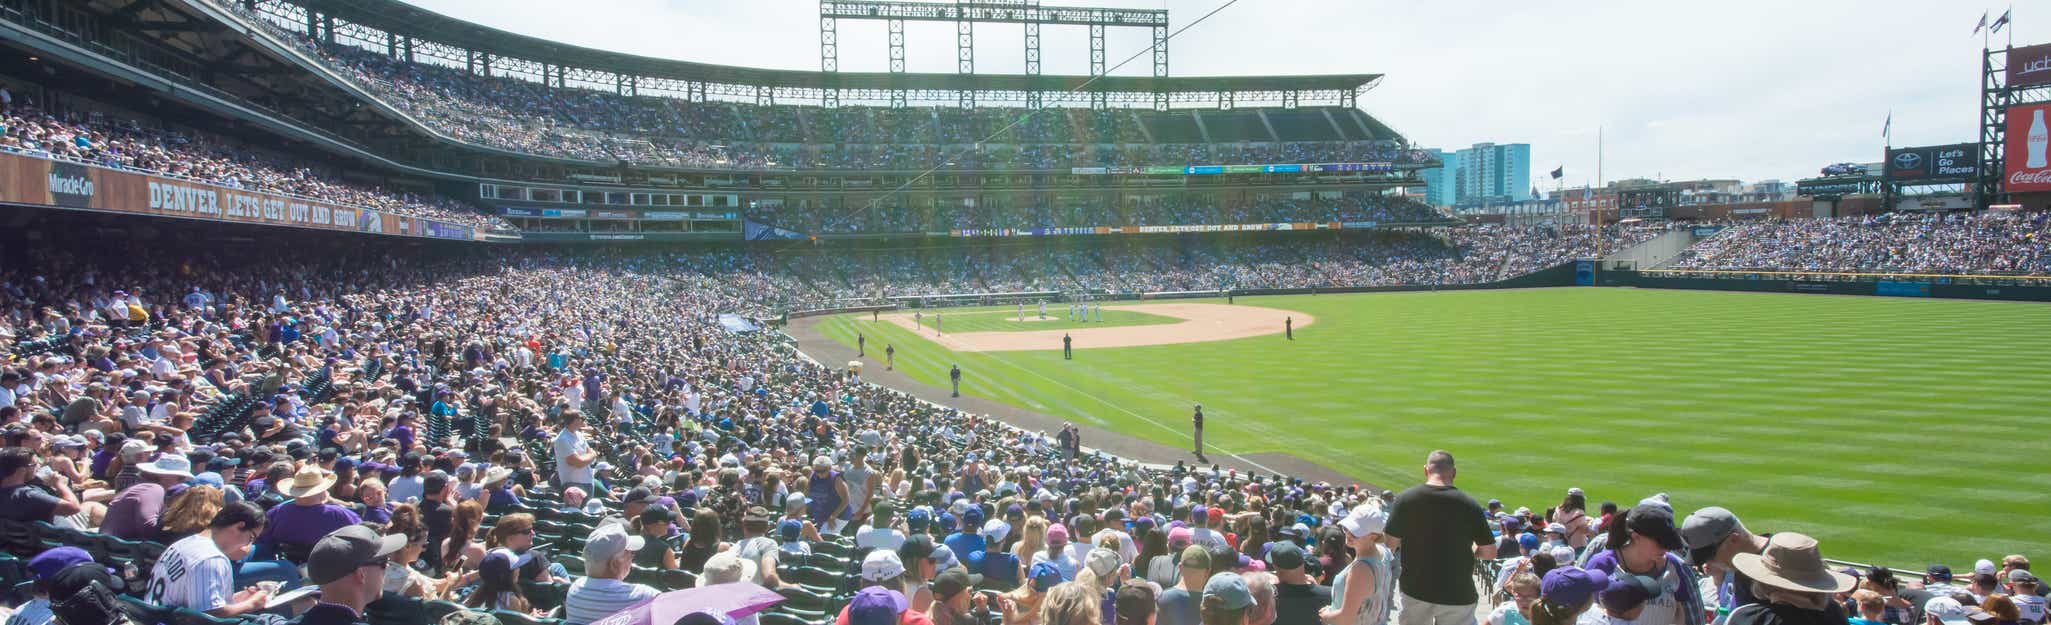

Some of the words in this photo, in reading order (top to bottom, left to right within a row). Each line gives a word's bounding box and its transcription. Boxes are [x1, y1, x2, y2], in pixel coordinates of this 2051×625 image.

[1939, 150, 1964, 158] Let's
[1938, 166, 1975, 174] Places
[48, 173, 94, 195] Miracle-Gro
[149, 182, 222, 214] DENVER,
[225, 192, 260, 218] LETS
[263, 199, 285, 220] GET
[289, 203, 309, 222] OUT
[312, 206, 330, 224] AND
[333, 209, 355, 226] GROW
